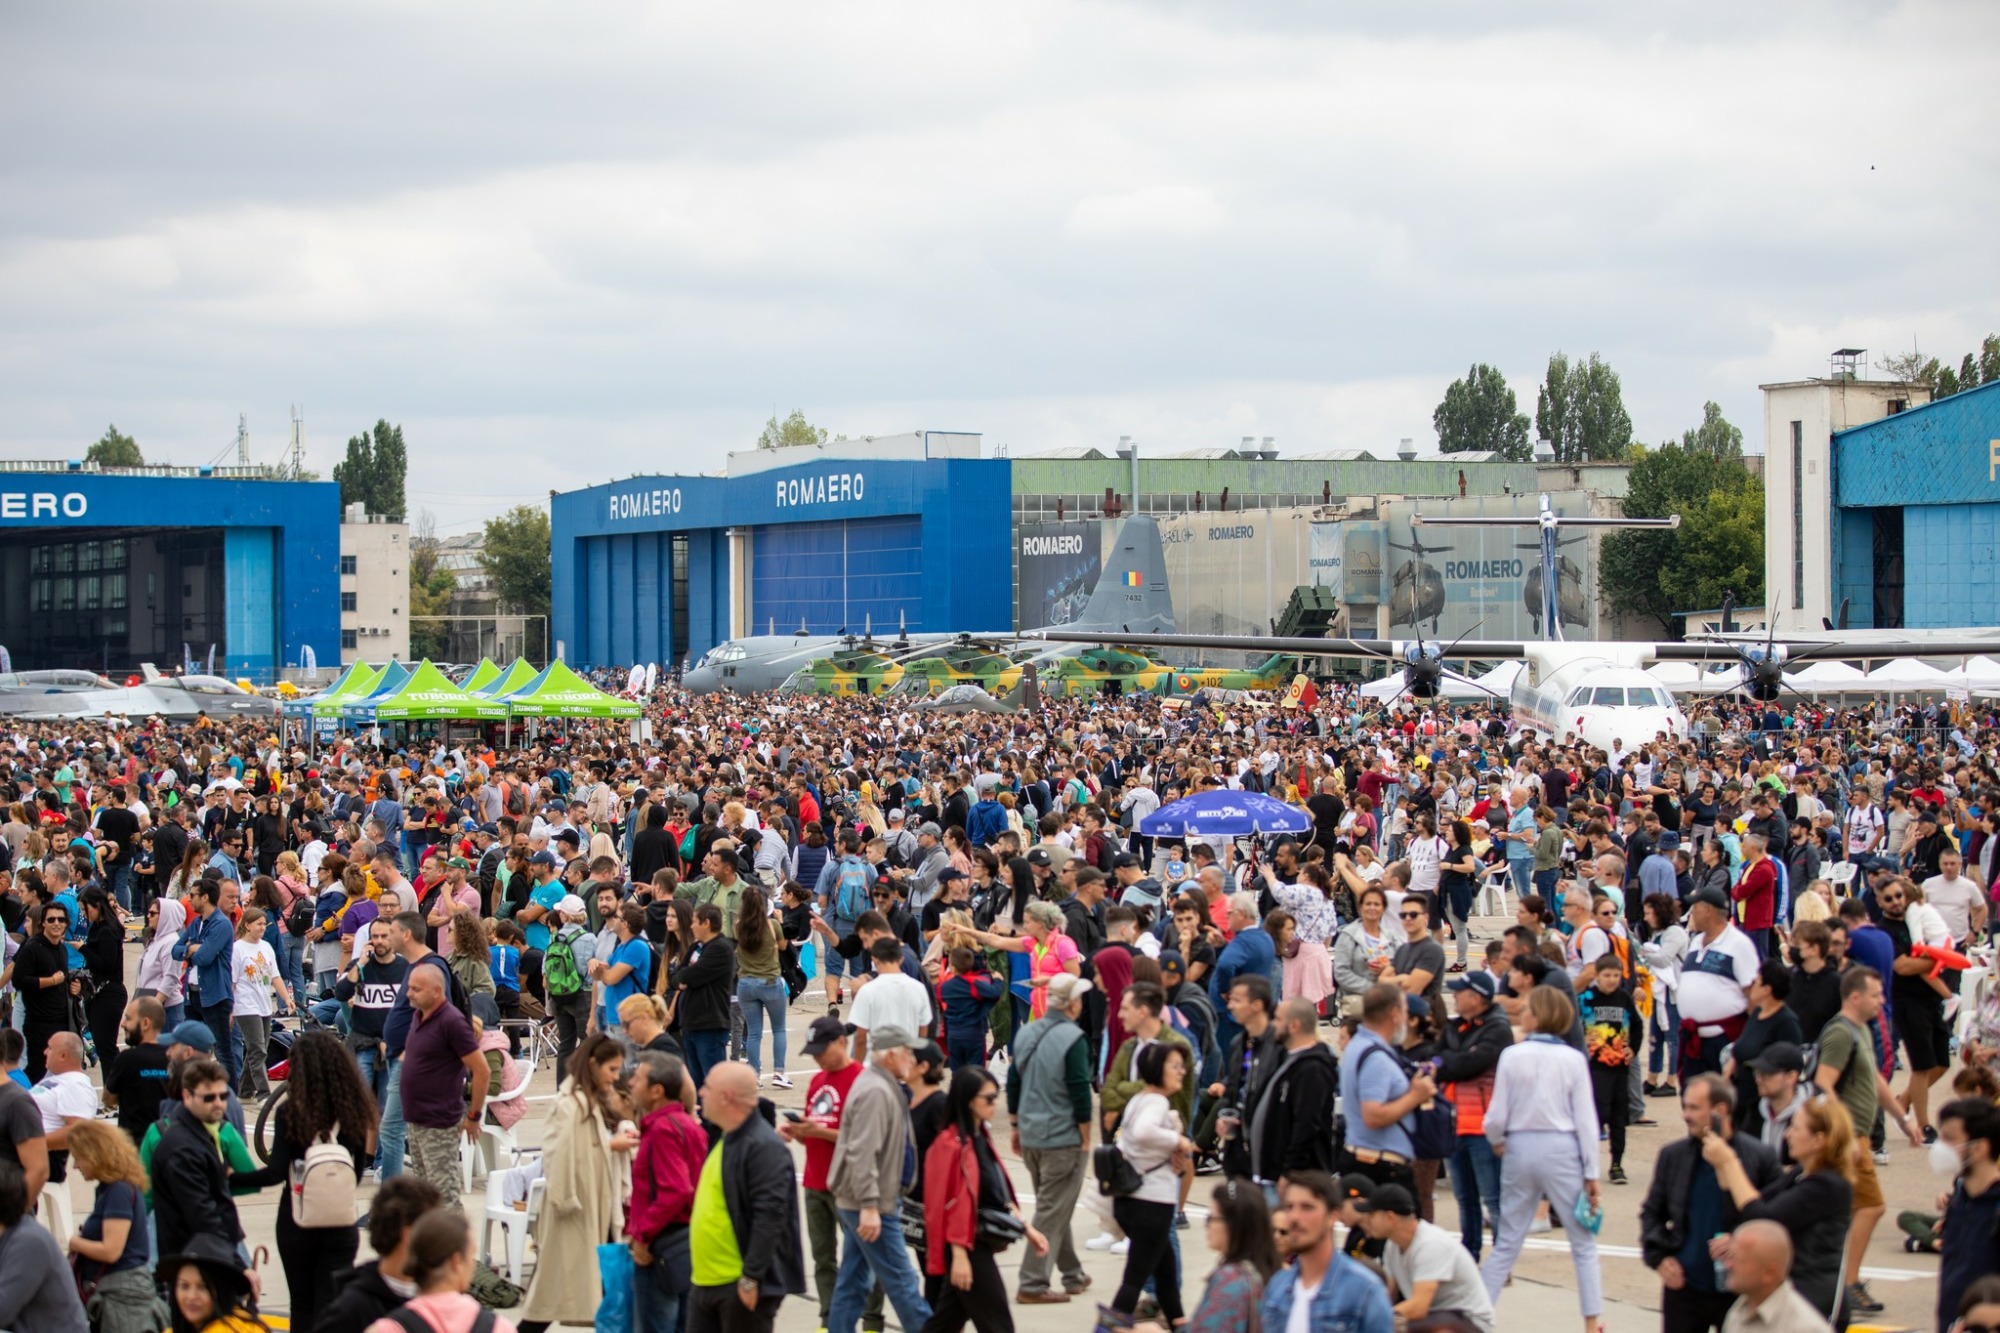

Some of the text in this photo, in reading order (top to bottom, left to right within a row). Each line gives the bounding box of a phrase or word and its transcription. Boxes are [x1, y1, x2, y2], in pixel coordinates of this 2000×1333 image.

[776, 472, 865, 507] ROMAERO
[1, 492, 88, 518] ERO
[610, 488, 682, 520] ROMAERO
[1208, 525, 1254, 541] ROMAERO
[1023, 534, 1083, 556] ROMAERO
[1310, 557, 1341, 568] ROMAERO
[1445, 558, 1523, 580] ROMAERO
[1125, 594, 1142, 602] 7432
[1206, 677, 1224, 687] 102
[406, 692, 470, 701] TUBORG
[541, 692, 603, 701] TUBORG
[378, 708, 409, 716] TUBORG
[476, 707, 506, 716] TUBORG
[514, 705, 543, 713] TUBORG
[609, 706, 640, 715] TUBORG
[360, 988, 396, 1004] NAS
